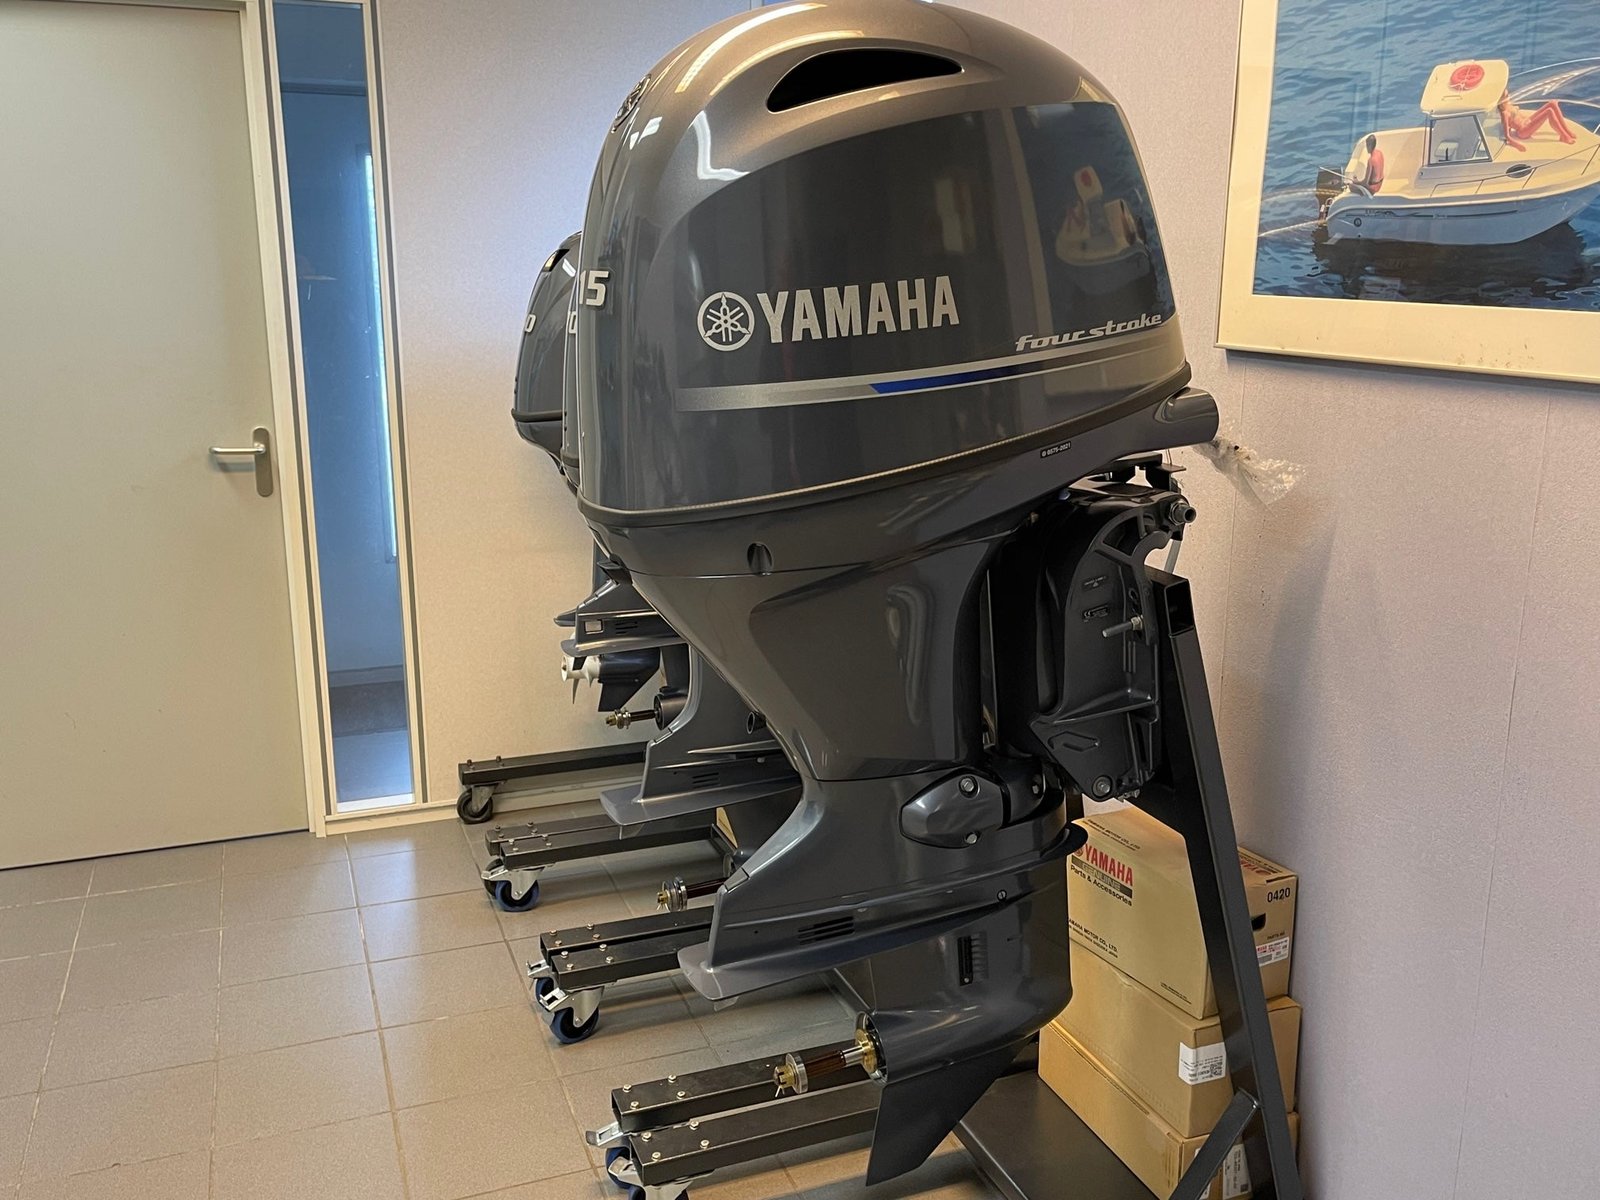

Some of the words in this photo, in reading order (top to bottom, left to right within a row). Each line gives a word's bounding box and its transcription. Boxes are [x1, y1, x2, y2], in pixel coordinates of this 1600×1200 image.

[757, 275, 960, 344] YAMAHA
[1071, 864, 1086, 879] Parts
[1093, 879, 1132, 906] Accessories
[1085, 843, 1133, 887] YAMAHA
[1267, 887, 1291, 903] 0420
[1069, 918, 1083, 931] AMAHA
